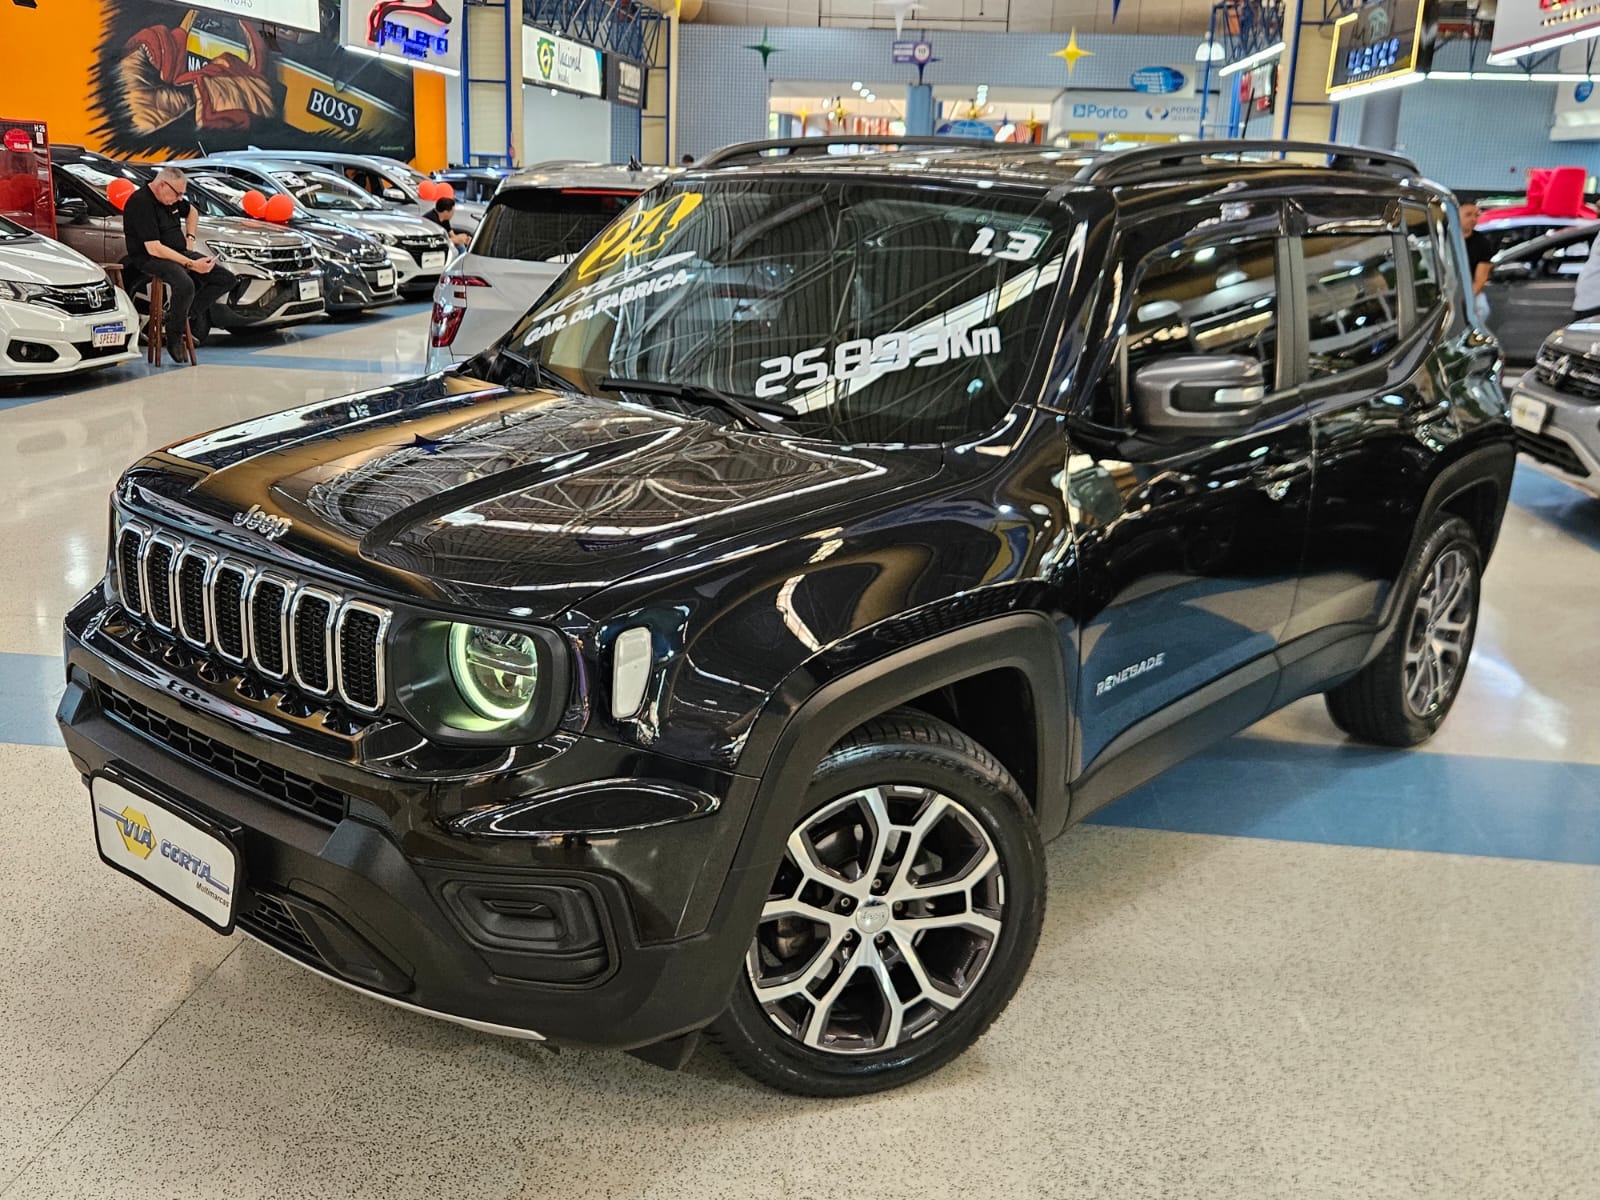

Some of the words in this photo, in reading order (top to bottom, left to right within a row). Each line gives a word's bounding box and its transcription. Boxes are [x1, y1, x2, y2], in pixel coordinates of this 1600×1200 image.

[310, 91, 358, 127] BOSS
[1086, 104, 1128, 119] Porto
[577, 191, 704, 281] 24
[968, 226, 1033, 262] 1.3
[232, 503, 293, 542] Jeep
[1096, 652, 1167, 697] RENEGADE
[121, 818, 153, 849] VIA
[160, 838, 212, 882] CERTA
[195, 882, 229, 908] Multimarcas
